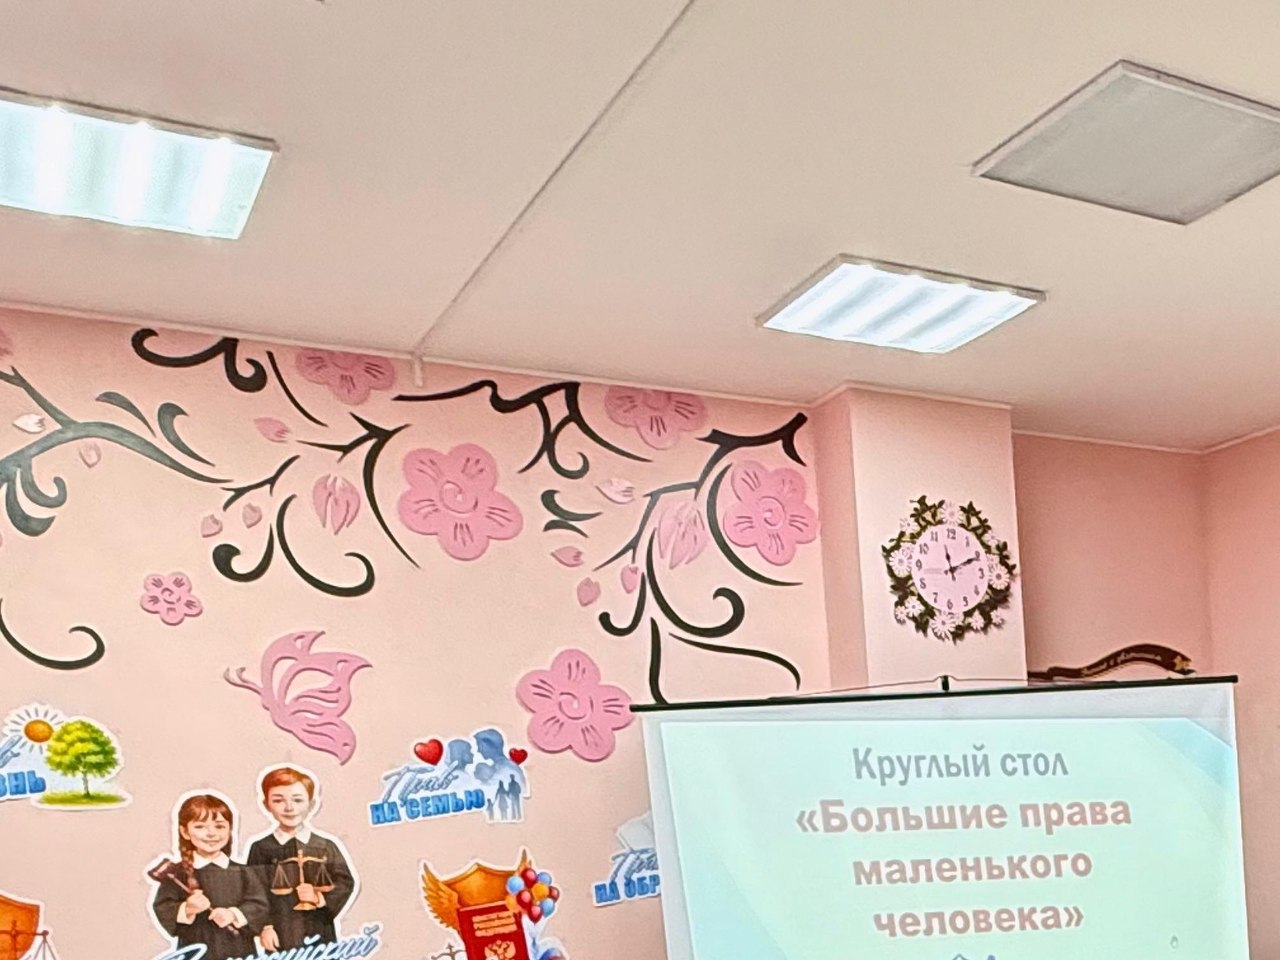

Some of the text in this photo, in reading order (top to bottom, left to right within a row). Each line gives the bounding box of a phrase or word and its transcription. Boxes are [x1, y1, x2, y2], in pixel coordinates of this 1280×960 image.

[853, 743, 1069, 786] Круглый стол
[370, 789, 486, 825] НА СЕМЬЮ
[796, 799, 1132, 835] «Большие права
[853, 852, 1093, 886] маленького
[594, 880, 620, 904] НА
[873, 905, 1085, 938] человека»
